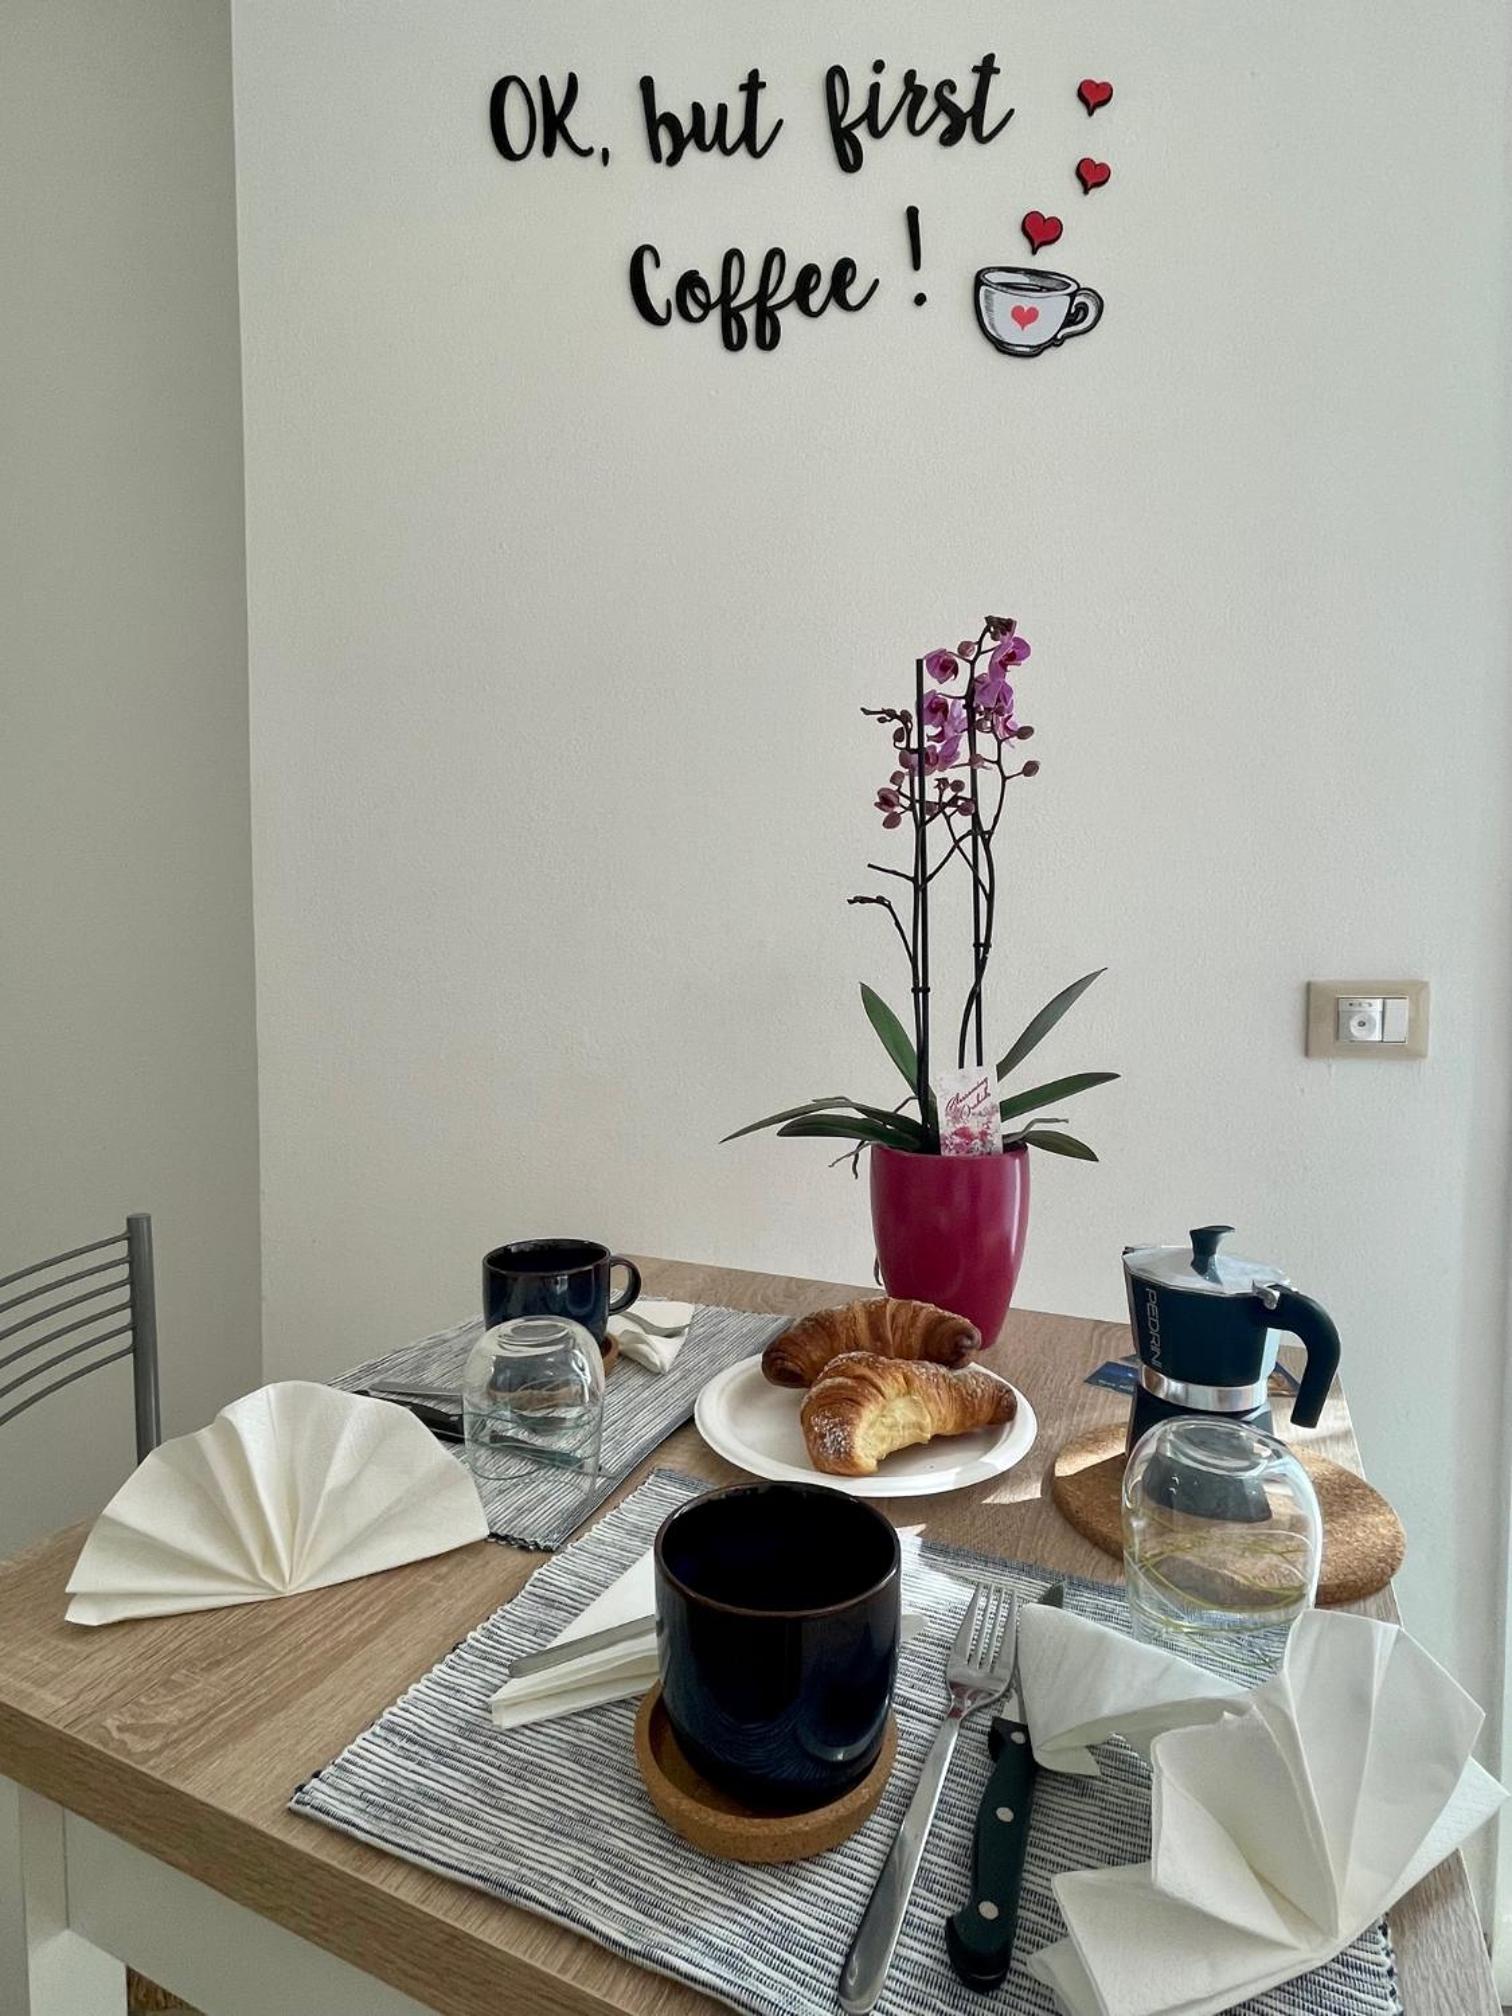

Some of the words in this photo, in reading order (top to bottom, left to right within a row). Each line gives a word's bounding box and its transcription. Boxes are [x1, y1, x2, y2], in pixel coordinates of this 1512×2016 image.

[489, 73, 610, 168] OK,
[639, 67, 785, 169] but
[825, 52, 1016, 175] first
[629, 244, 880, 353] Coffee
[1145, 1287, 1162, 1368] PEDRINI
